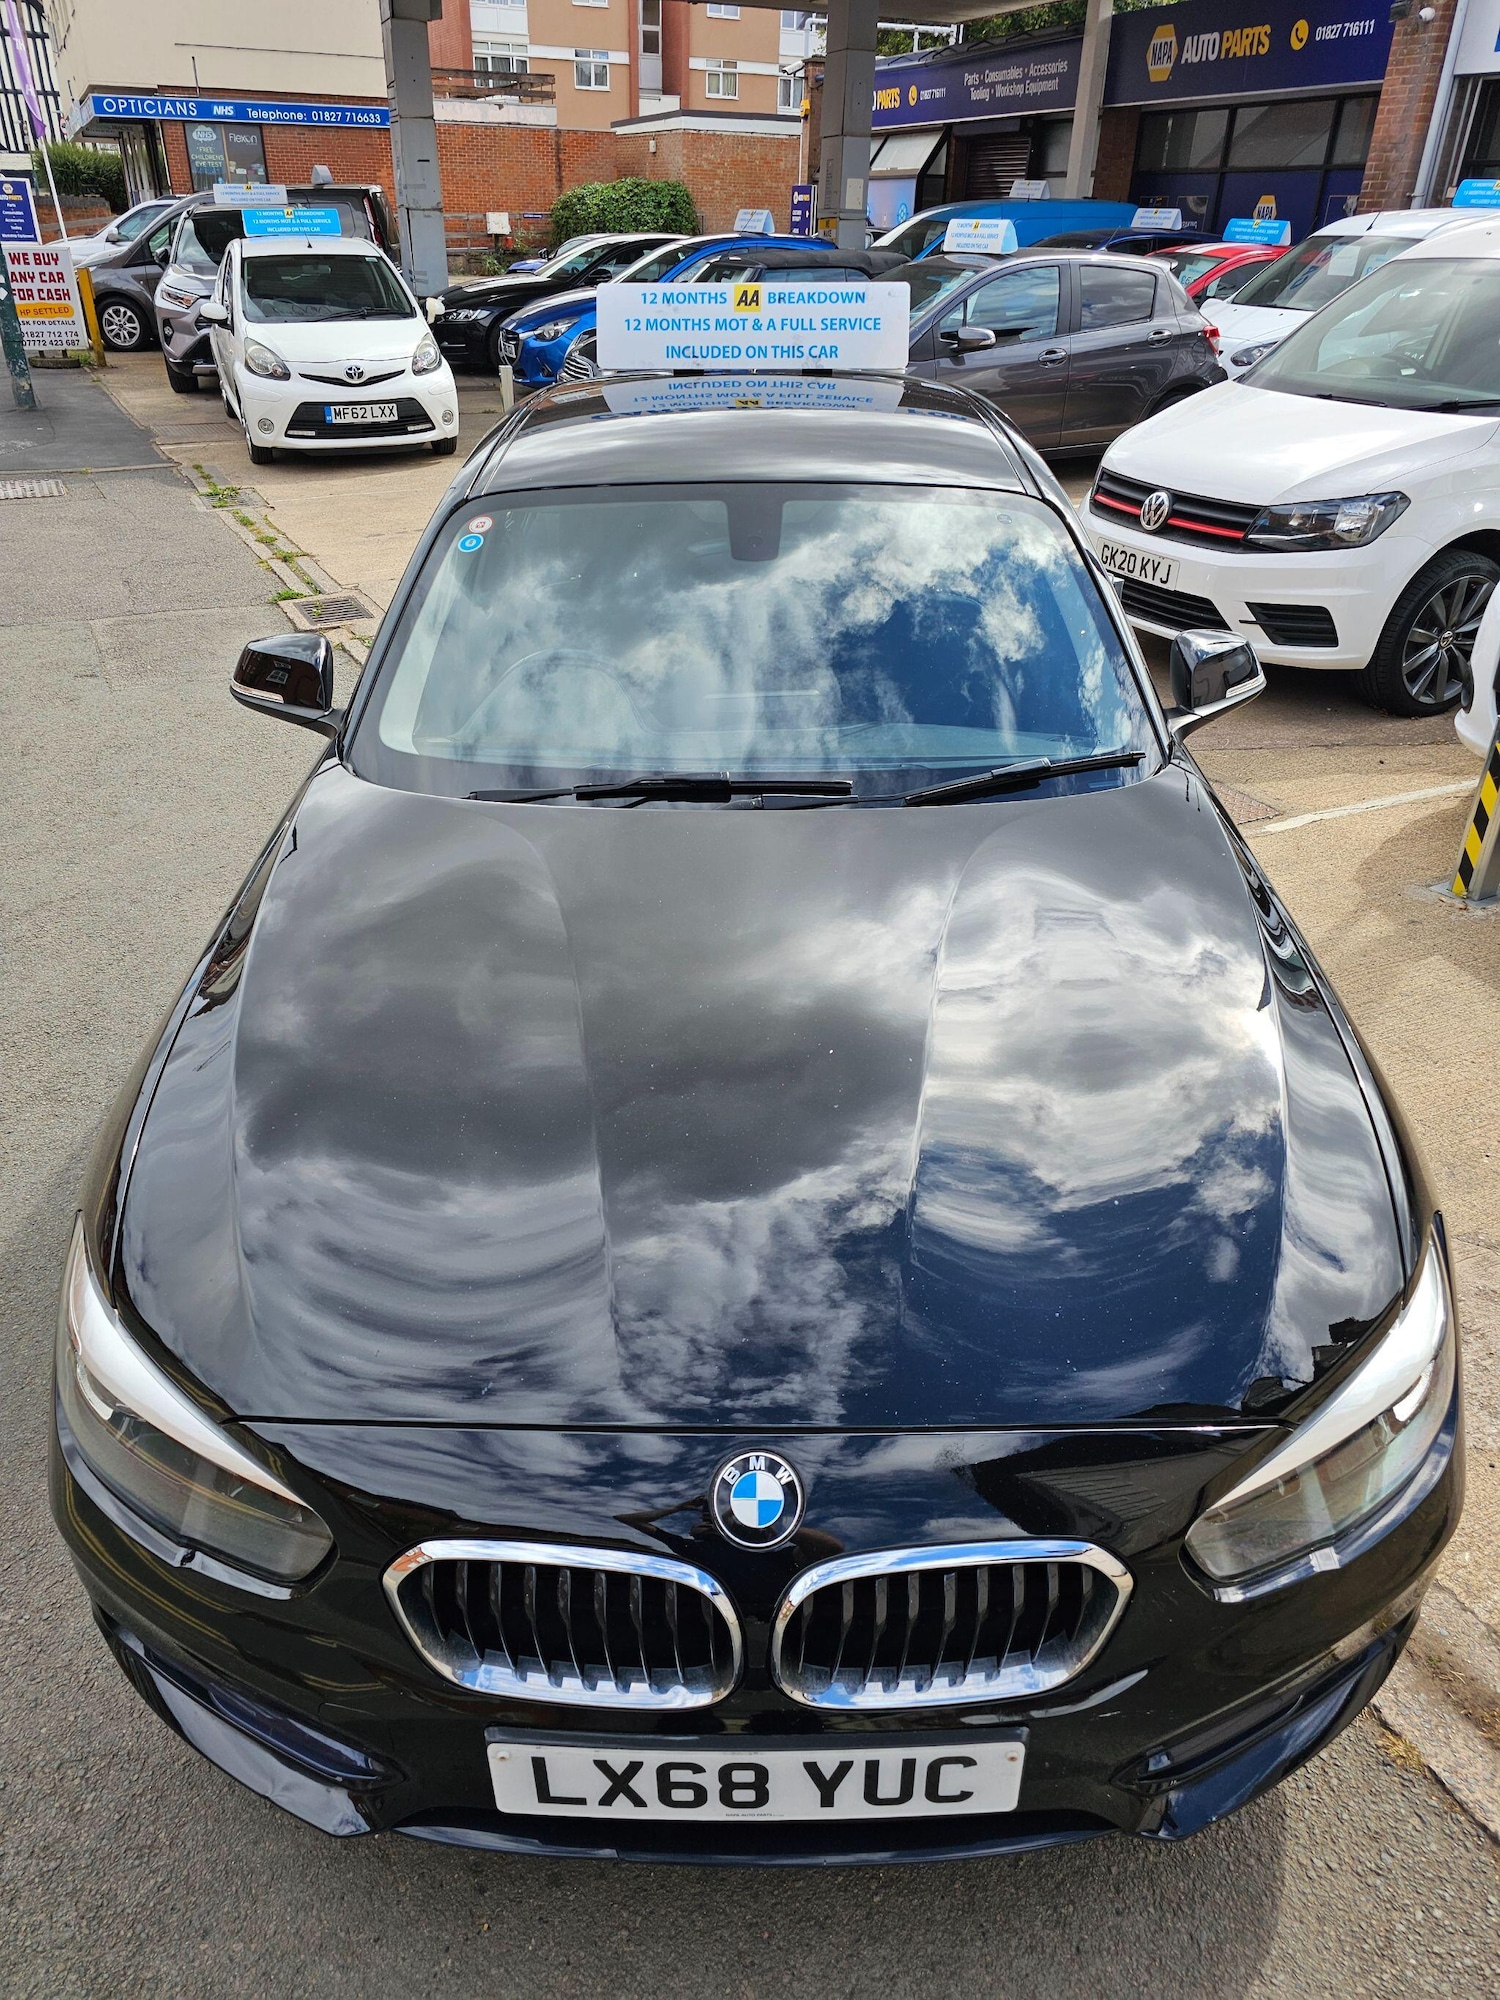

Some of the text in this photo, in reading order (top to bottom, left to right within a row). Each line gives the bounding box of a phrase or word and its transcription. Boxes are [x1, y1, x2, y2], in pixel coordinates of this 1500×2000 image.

[1315, 19, 1375, 41] 01827 716111
[1151, 39, 1173, 66] NAPA
[1181, 24, 1271, 64] AUTO PARTS
[964, 59, 1068, 86] Parts Consumables Accessories
[970, 77, 1059, 102] Tooling Workshop Equipment
[103, 98, 198, 116] OPTICIANS
[876, 87, 900, 110] PARTS
[213, 105, 234, 116] NHS
[246, 107, 381, 124] Telephone: 01827 716633
[8, 253, 59, 266] WE BUY
[10, 272, 65, 283] ANY CAR
[38, 289, 71, 300] CASH
[641, 290, 866, 307] 12 MONTHS AA BREAKDOWN
[33, 307, 70, 315] SETTLED
[625, 317, 881, 331] 12 MONTHS MOT & A FULL SERVICE
[666, 345, 838, 359] INCLUDED ON THIS CAR
[333, 407, 368, 420] MF62
[370, 405, 396, 418] LXX
[1100, 543, 1172, 585] GK20 KYJ
[722, 1455, 794, 1486] BMW
[531, 1755, 978, 1809] LX68 YUC
